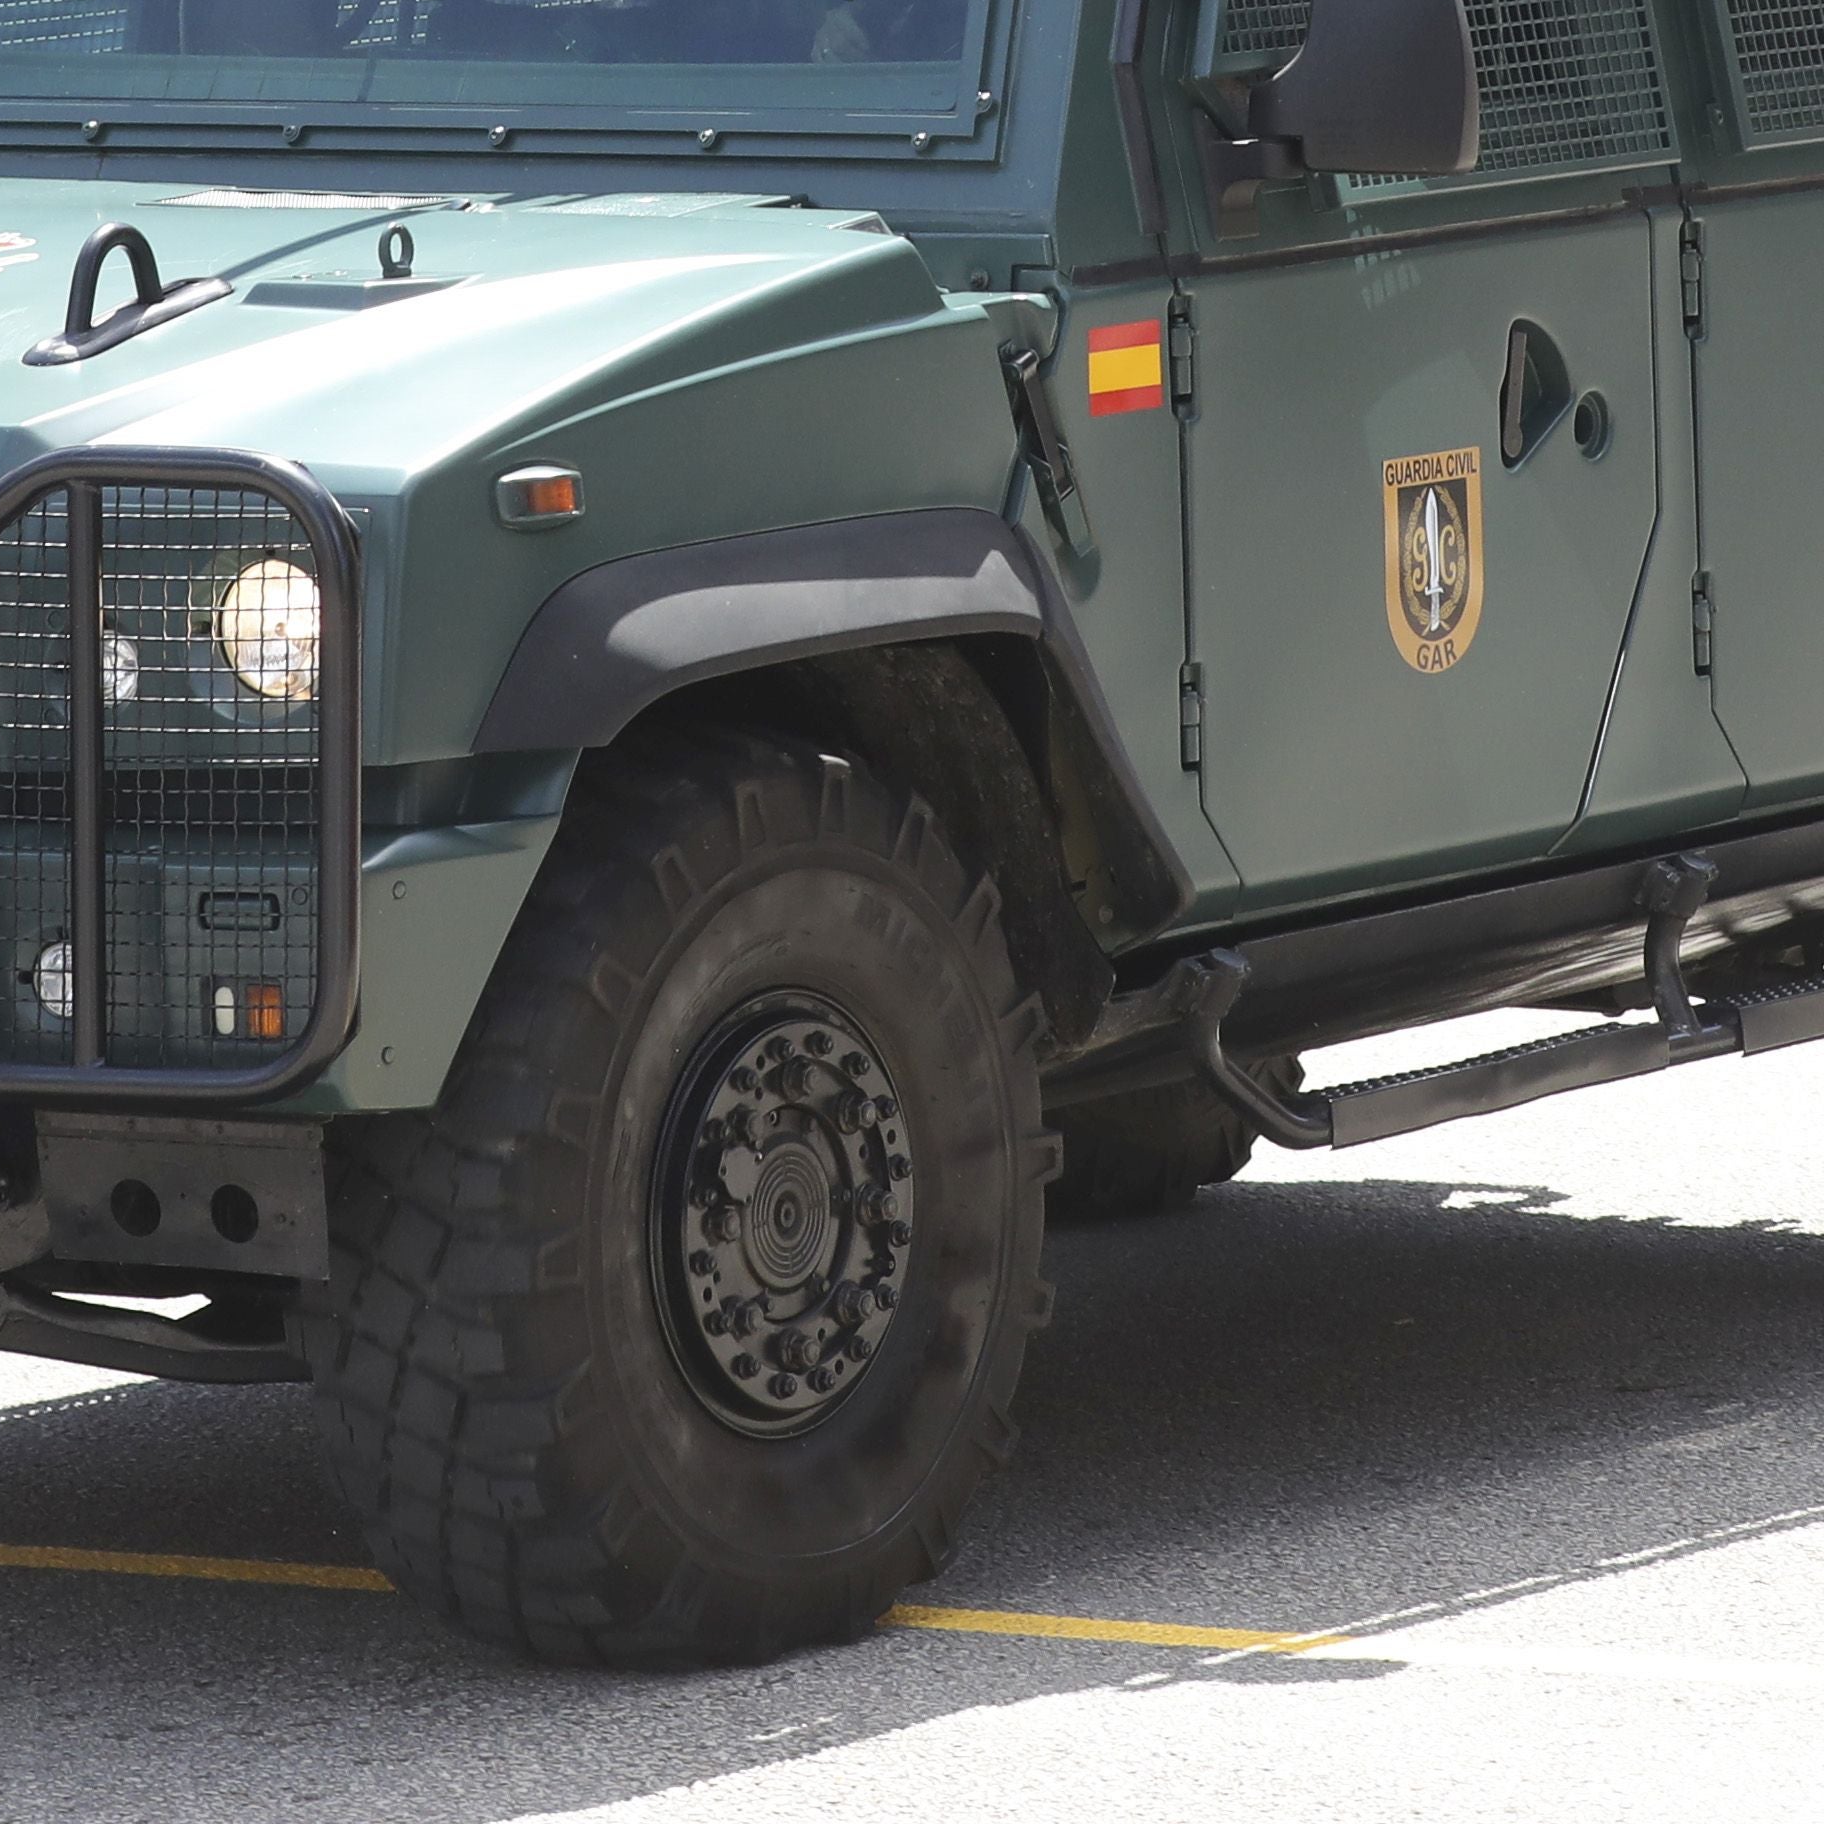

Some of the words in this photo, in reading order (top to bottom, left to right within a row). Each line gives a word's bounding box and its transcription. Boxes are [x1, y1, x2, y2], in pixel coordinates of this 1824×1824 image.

[1384, 457, 1444, 487] GUARDIA
[1445, 455, 1478, 476] CIVIL
[1416, 638, 1458, 672] GAR
